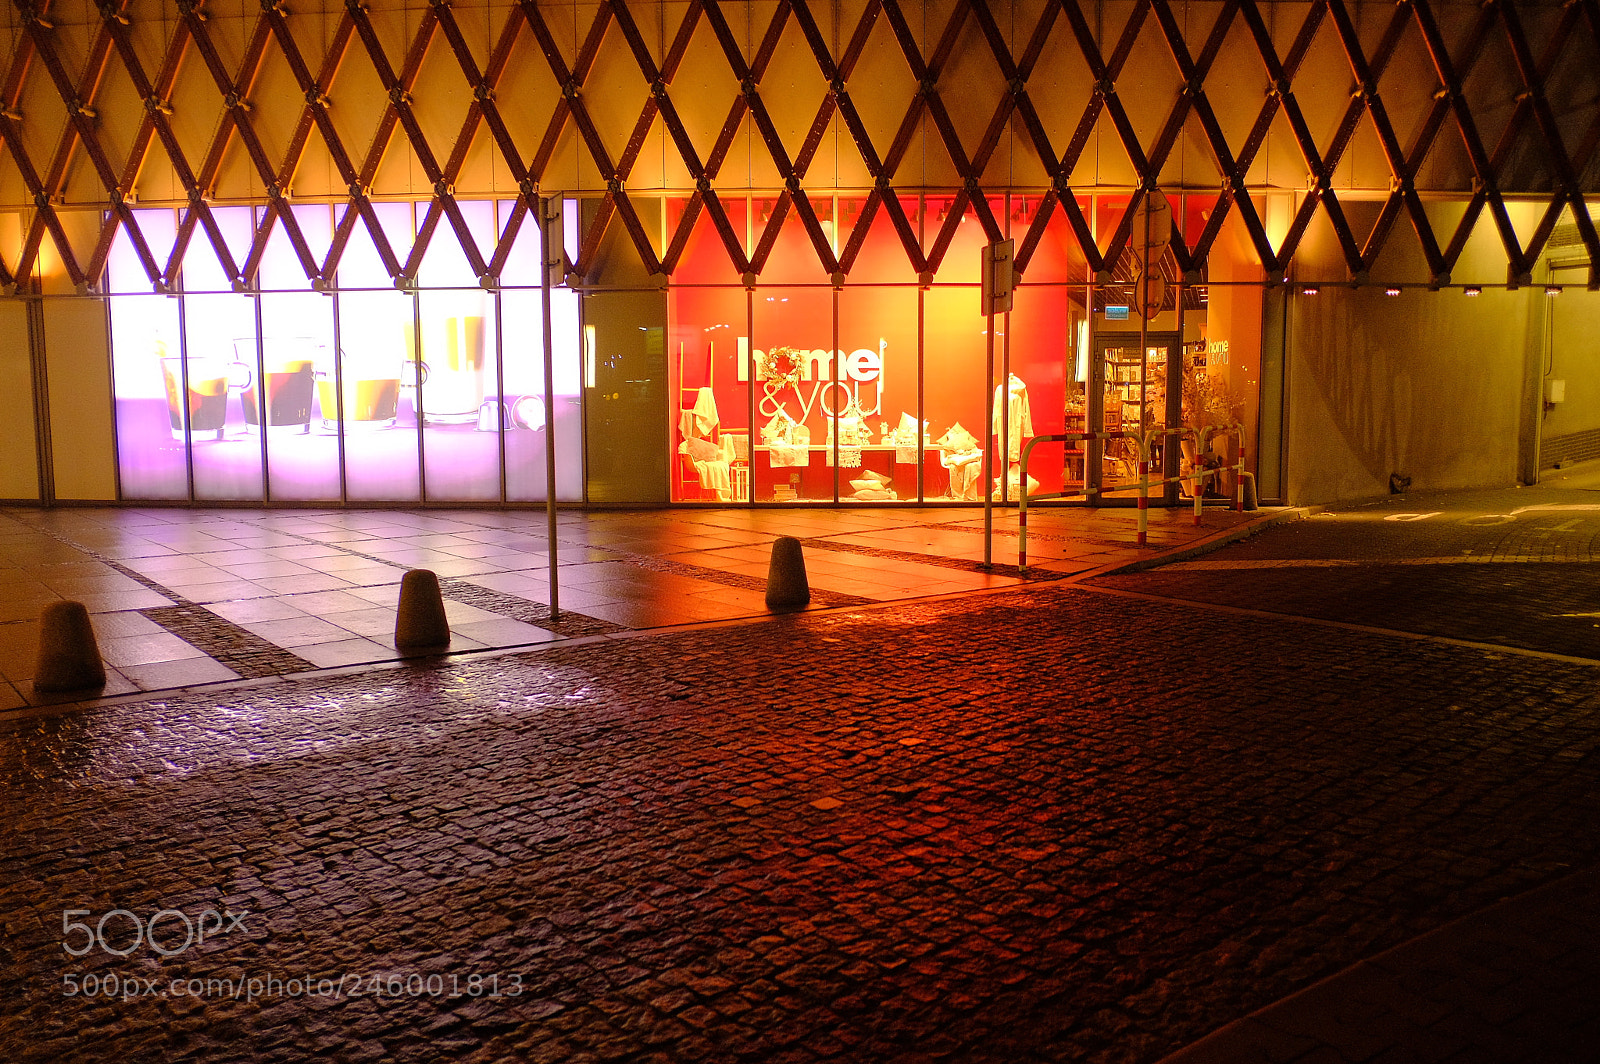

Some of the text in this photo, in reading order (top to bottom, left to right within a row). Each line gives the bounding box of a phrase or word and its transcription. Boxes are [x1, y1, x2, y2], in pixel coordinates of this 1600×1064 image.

[737, 337, 880, 382] hme
[1208, 338, 1229, 353] home
[794, 381, 882, 426] you
